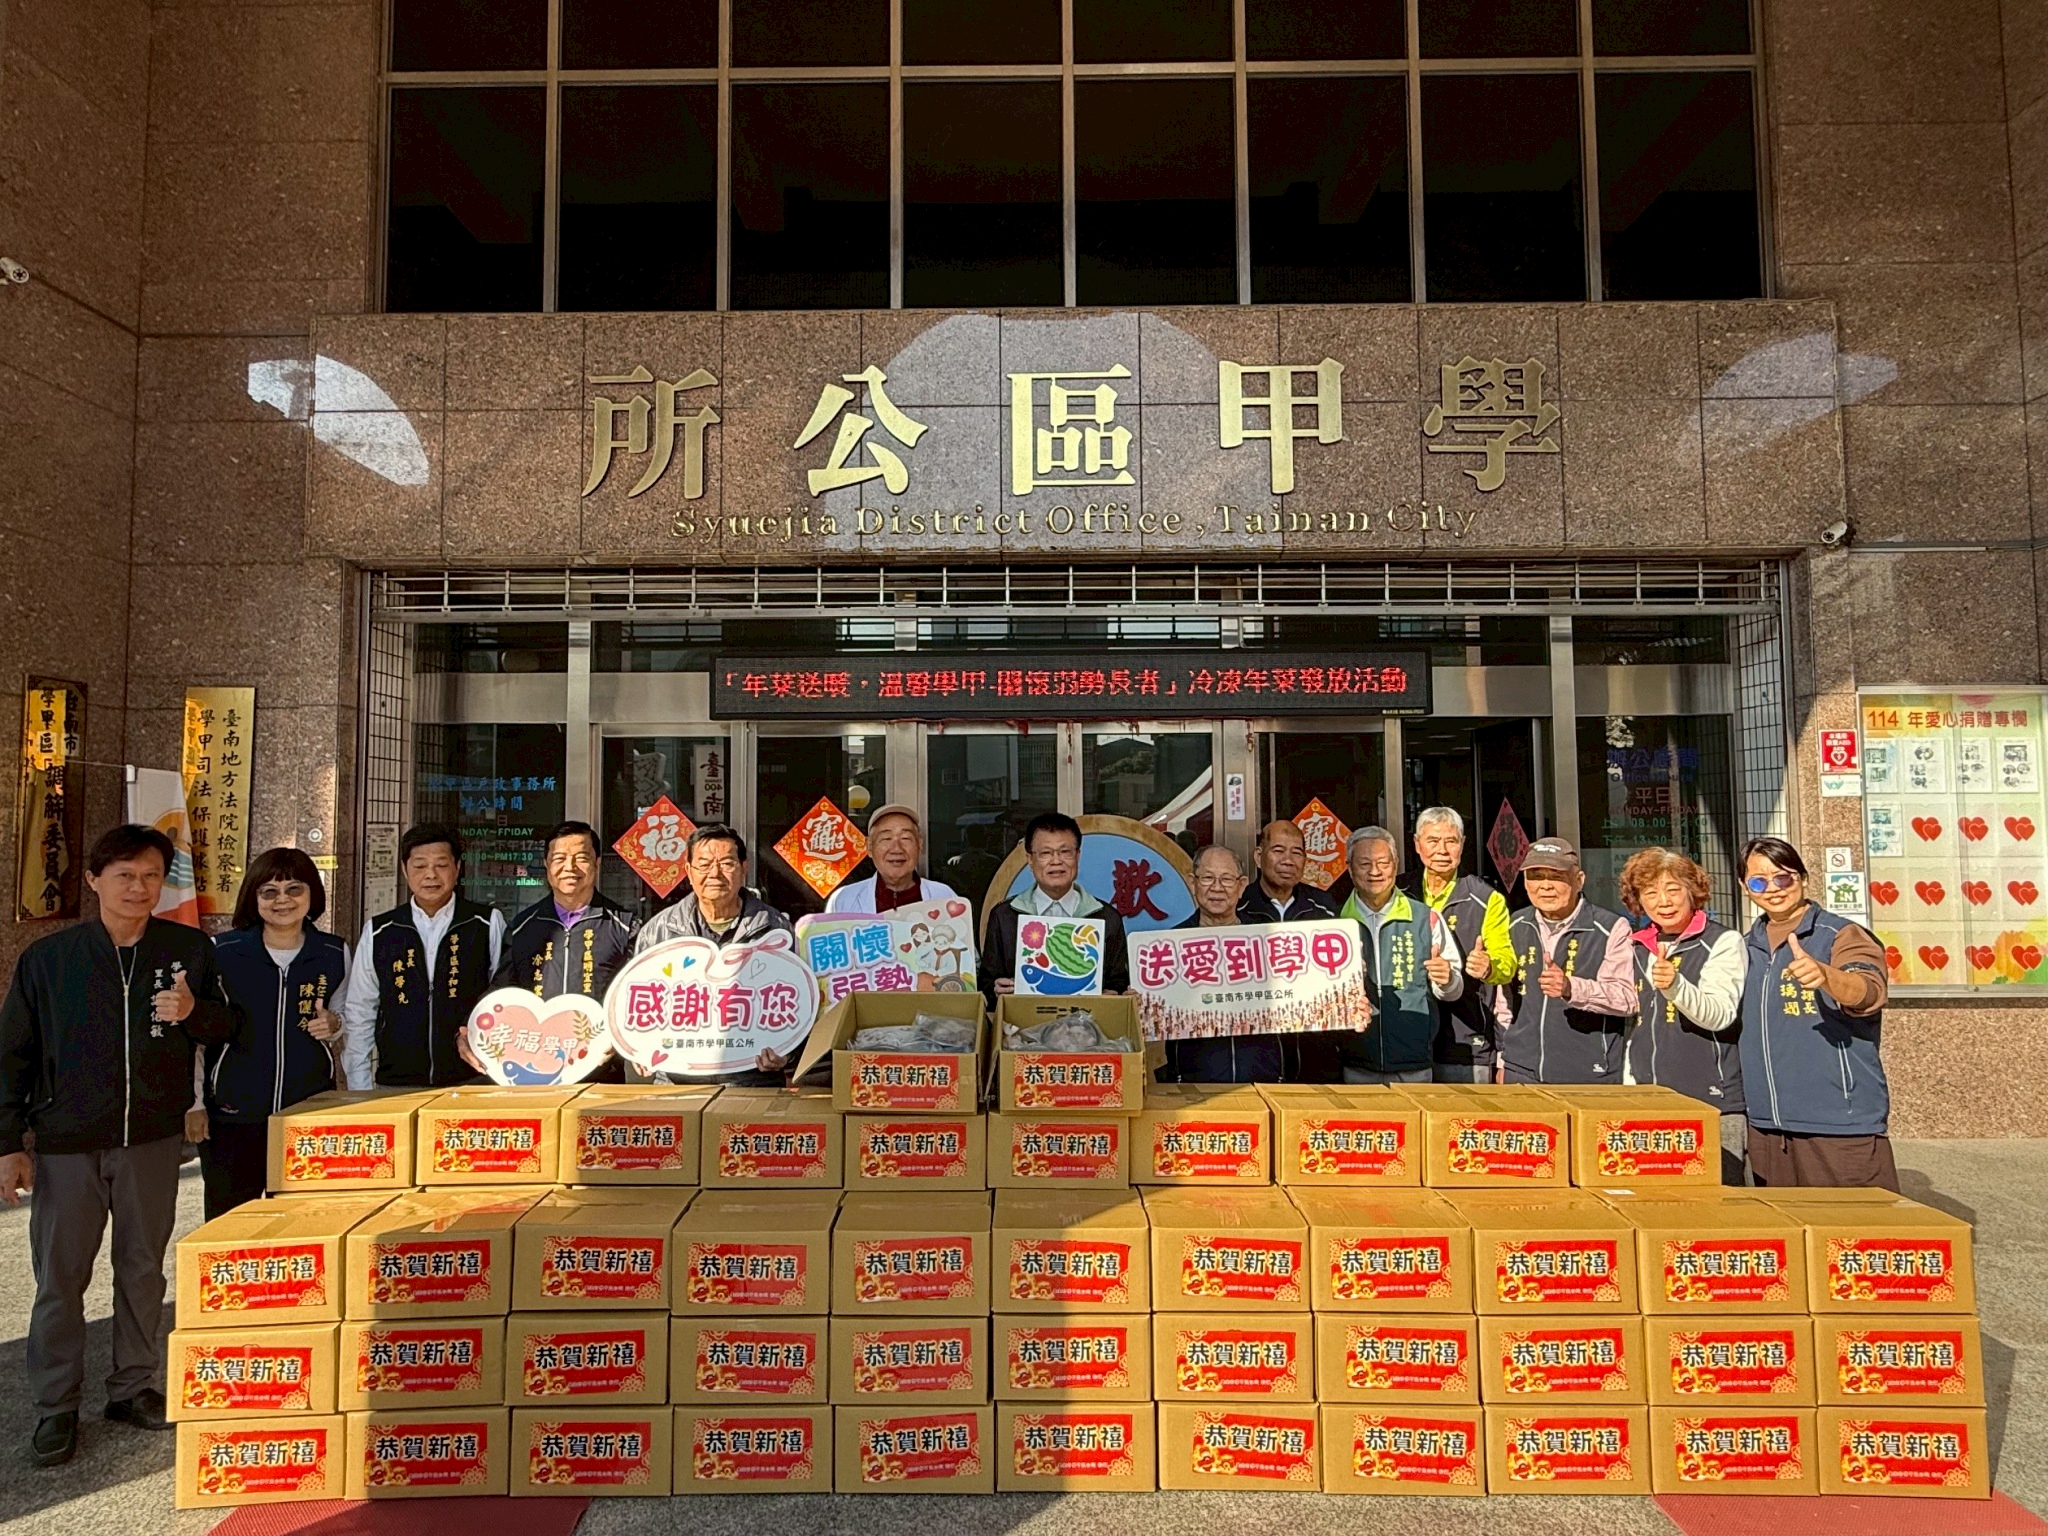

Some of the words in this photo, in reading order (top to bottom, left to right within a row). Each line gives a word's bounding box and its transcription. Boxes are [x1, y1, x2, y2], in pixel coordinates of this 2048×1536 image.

[671, 504, 839, 543] Syuejia
[855, 505, 1033, 535] District
[1212, 502, 1372, 535] Tainan
[1388, 502, 1477, 538] City
[1868, 709, 1899, 728] 114
[1907, 709, 2029, 729] 年愛心捐贈專欄
[215, 708, 243, 893] 臺南地方法院檢察署
[808, 922, 893, 973] 關懷
[1139, 932, 1350, 988] 送愛到學甲
[154, 968, 164, 989] 里長
[625, 982, 798, 1030] 感謝有您
[1214, 989, 1294, 1004] 臺南市學甲區公所
[490, 1022, 580, 1056] 幸福學甲
[675, 1037, 755, 1049] 臺南市學甲區公所
[862, 1066, 947, 1085] 恭賀新禧
[1025, 1065, 1111, 1084] 恭賀新禧
[296, 1134, 386, 1157] 恭賀新禧
[444, 1127, 533, 1151] 恭賀新禧
[588, 1127, 672, 1146] 恭賀新禧
[730, 1135, 816, 1154] 恭賀新禧
[871, 1134, 956, 1154] 恭賀新禧
[1023, 1135, 1107, 1154] 恭賀新禧
[1165, 1135, 1250, 1151] 恭賀新禧
[1312, 1133, 1394, 1149] 恭賀新禧
[1463, 1131, 1547, 1151] 恭賀新禧
[1610, 1133, 1695, 1149] 恭賀新禧
[381, 1253, 479, 1277] 恭賀新禧
[555, 1249, 651, 1271] 恭賀新禧
[700, 1256, 795, 1278] 恭賀新禧
[867, 1249, 961, 1274] 恭賀新禧
[1022, 1253, 1119, 1274] 恭賀新禧
[1196, 1250, 1288, 1271] 恭賀新禧
[1345, 1250, 1437, 1272] 恭賀新禧
[1509, 1253, 1604, 1275] 恭賀新禧
[1678, 1253, 1772, 1274] 恭賀新禧
[1842, 1253, 1939, 1272] 恭賀新禧
[211, 1258, 314, 1285] 恭賀新禧
[371, 1341, 470, 1365] 恭賀新禧
[536, 1343, 633, 1369] 恭賀新禧
[709, 1343, 804, 1367] 恭賀新禧
[865, 1341, 960, 1366] 恭賀新禧
[1021, 1340, 1114, 1362] 恭賀新禧
[1190, 1345, 1285, 1363] 恭賀新禧
[1360, 1340, 1457, 1361] 恭賀新禧
[1515, 1342, 1613, 1364] 恭賀新禧
[1685, 1345, 1781, 1366] 恭賀新禧
[1848, 1345, 1953, 1364] 恭賀新禧
[200, 1359, 298, 1382] 恭賀新禧
[377, 1435, 476, 1460] 恭賀新禧
[542, 1435, 639, 1457] 恭賀新禧
[705, 1430, 801, 1453] 恭賀新禧
[871, 1427, 967, 1454] 恭賀新禧
[1026, 1427, 1120, 1449] 恭賀新禧
[1207, 1426, 1303, 1455] 恭賀新禧
[1367, 1429, 1463, 1453] 恭賀新禧
[1520, 1431, 1616, 1451] 恭賀新禧
[1689, 1430, 1788, 1450] 恭賀新禧
[1852, 1434, 1957, 1456] 恭賀新禧
[213, 1440, 315, 1467] 恭賀新禧
